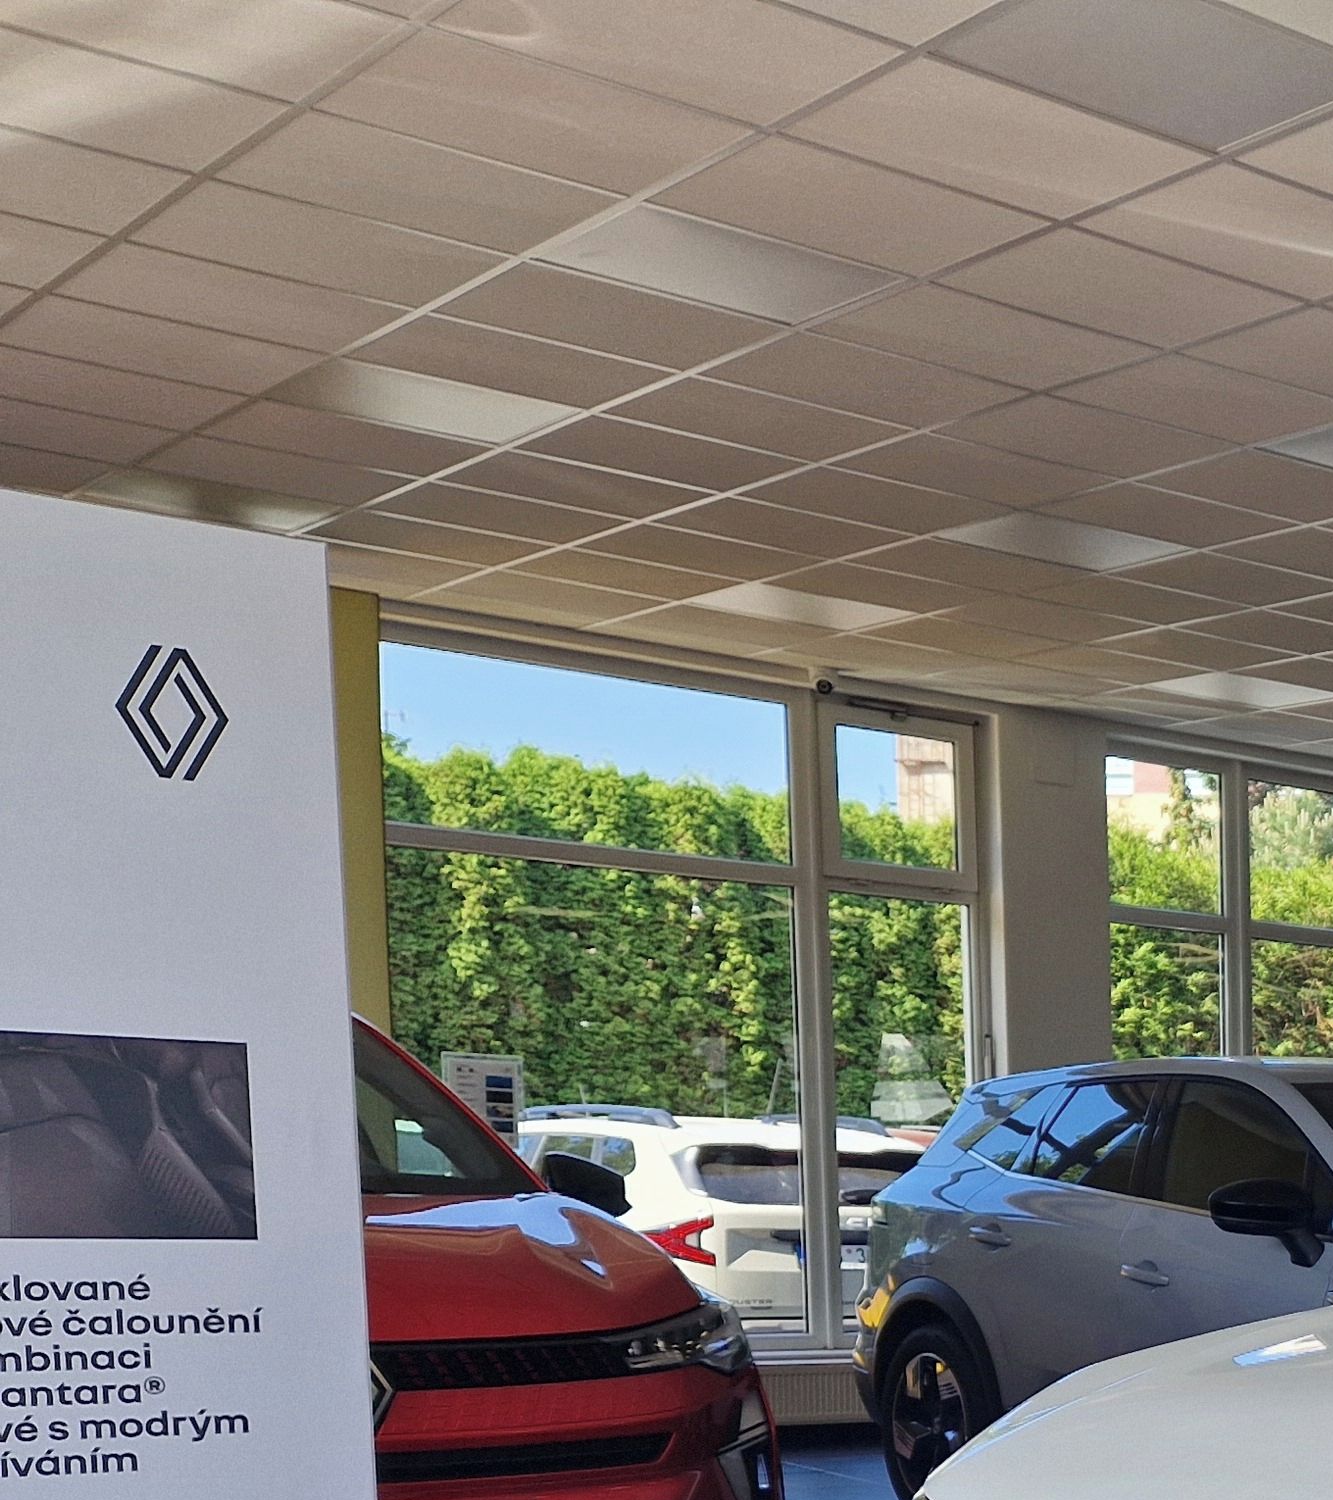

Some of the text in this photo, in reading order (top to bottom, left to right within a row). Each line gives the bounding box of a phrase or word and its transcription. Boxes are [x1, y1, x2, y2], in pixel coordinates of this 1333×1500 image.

[0, 1306, 263, 1337] vé čalounění
[48, 1420, 70, 1441] s
[79, 1408, 250, 1442] modrým
[0, 1446, 139, 1478] íváním
